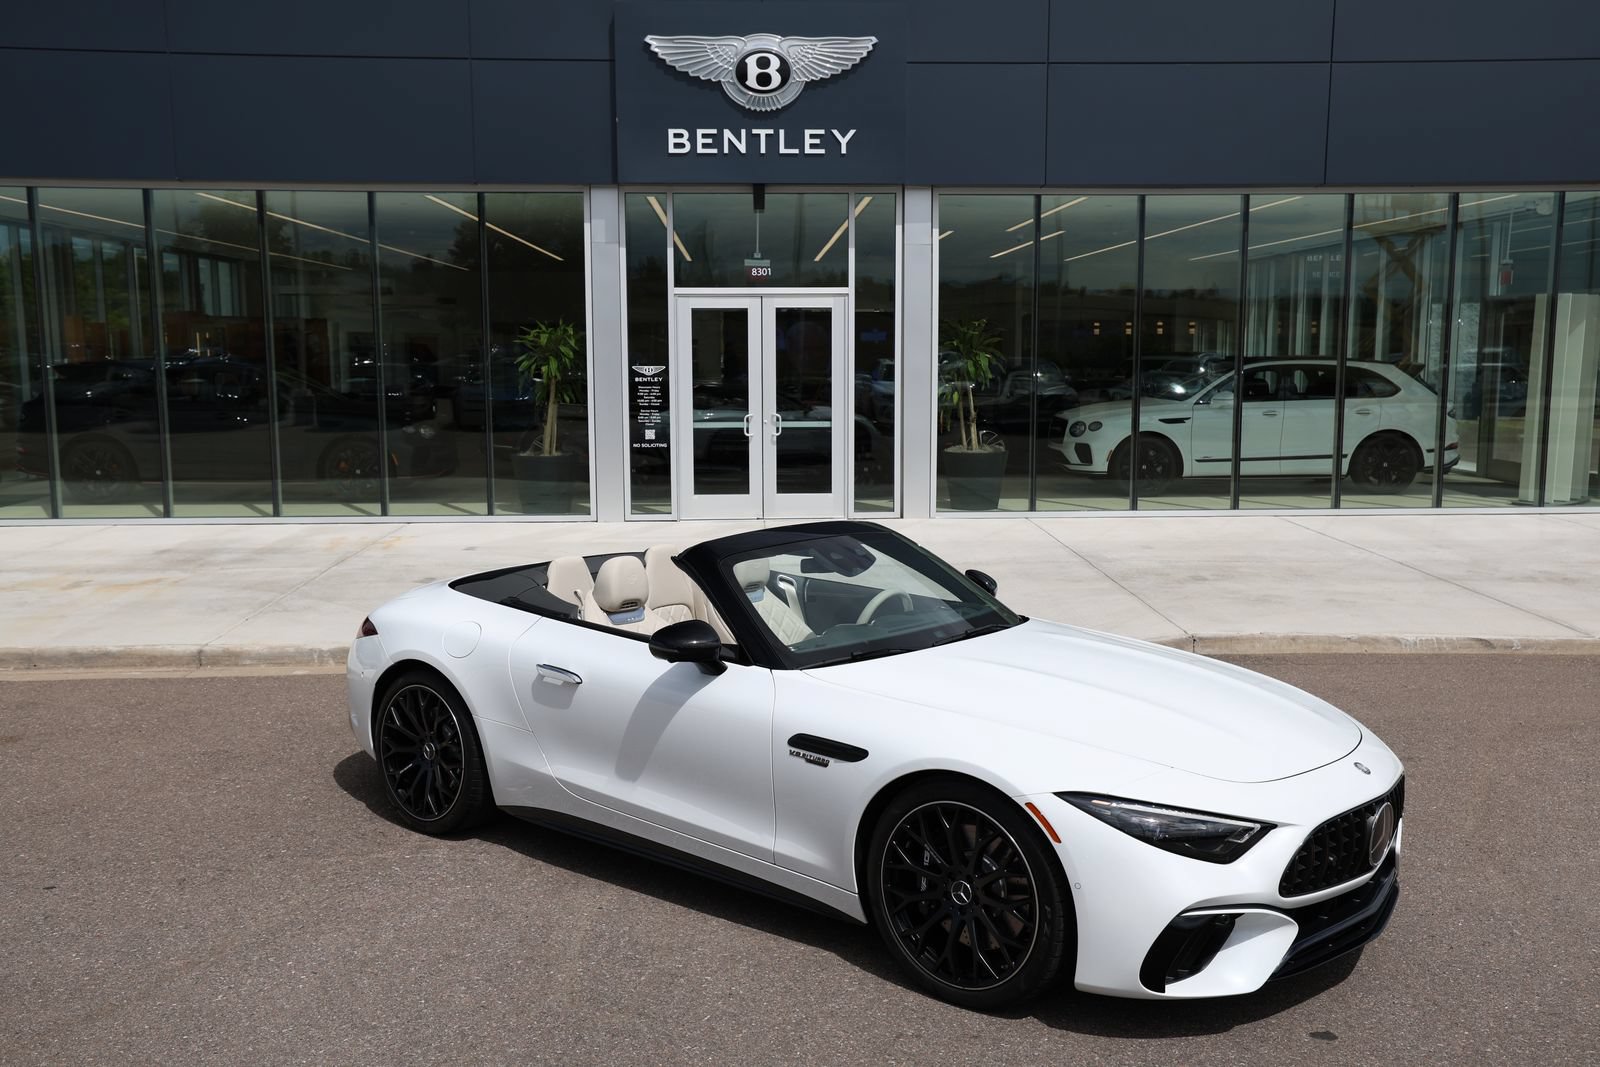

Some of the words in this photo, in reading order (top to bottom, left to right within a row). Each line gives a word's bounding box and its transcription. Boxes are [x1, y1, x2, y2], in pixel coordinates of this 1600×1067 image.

[744, 52, 782, 91] B
[668, 129, 857, 154] BENTLEY
[752, 267, 771, 276] 8301
[789, 749, 801, 757] V8
[801, 752, 830, 764] BITURBO
